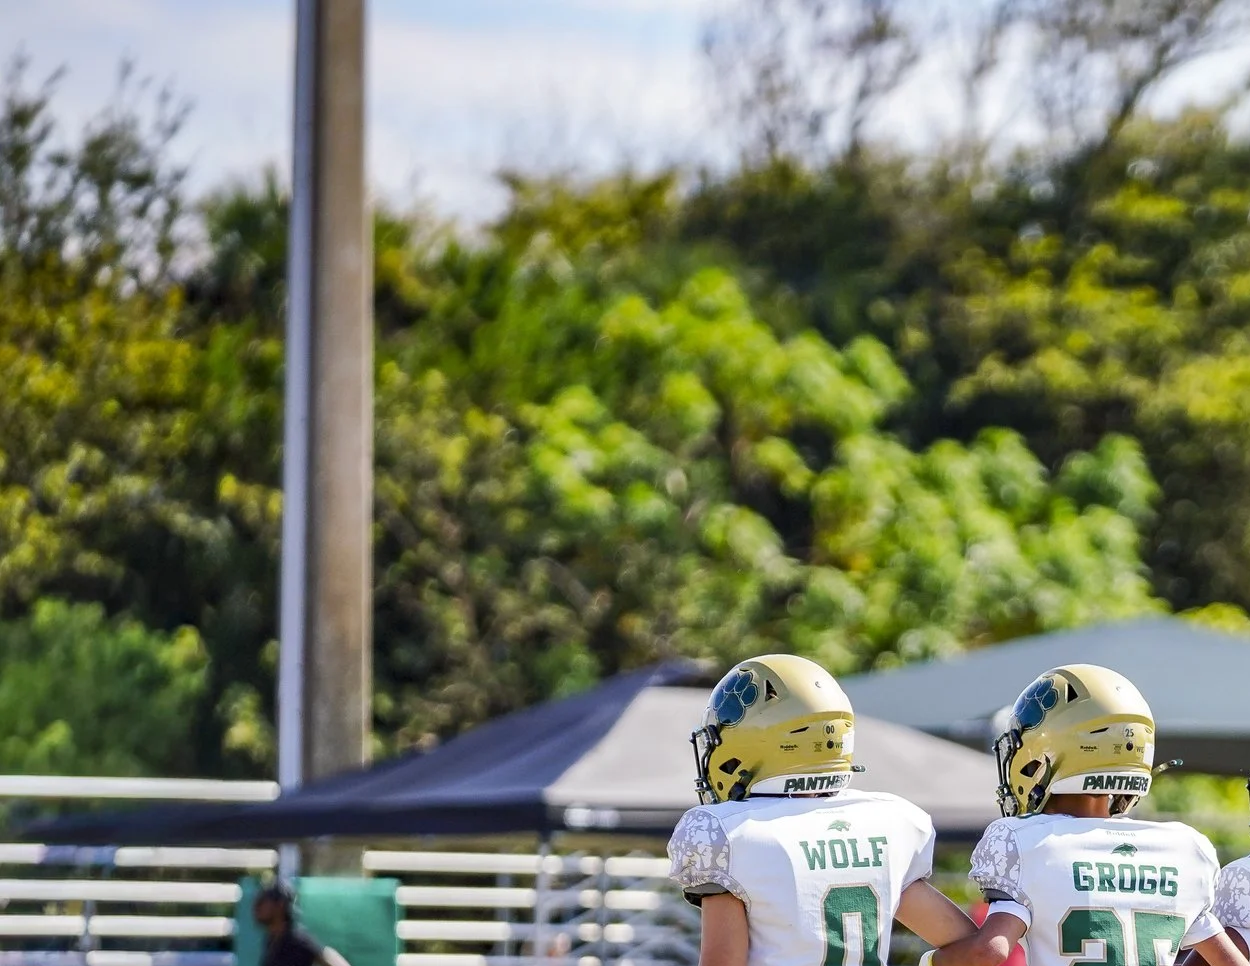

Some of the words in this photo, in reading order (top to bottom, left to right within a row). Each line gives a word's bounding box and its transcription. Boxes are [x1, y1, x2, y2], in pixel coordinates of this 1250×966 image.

[825, 725, 835, 734] 00
[1125, 728, 1135, 737] 25
[783, 775, 850, 793] PANTH
[799, 836, 888, 870] WOLF
[1072, 861, 1179, 897] GROGG
